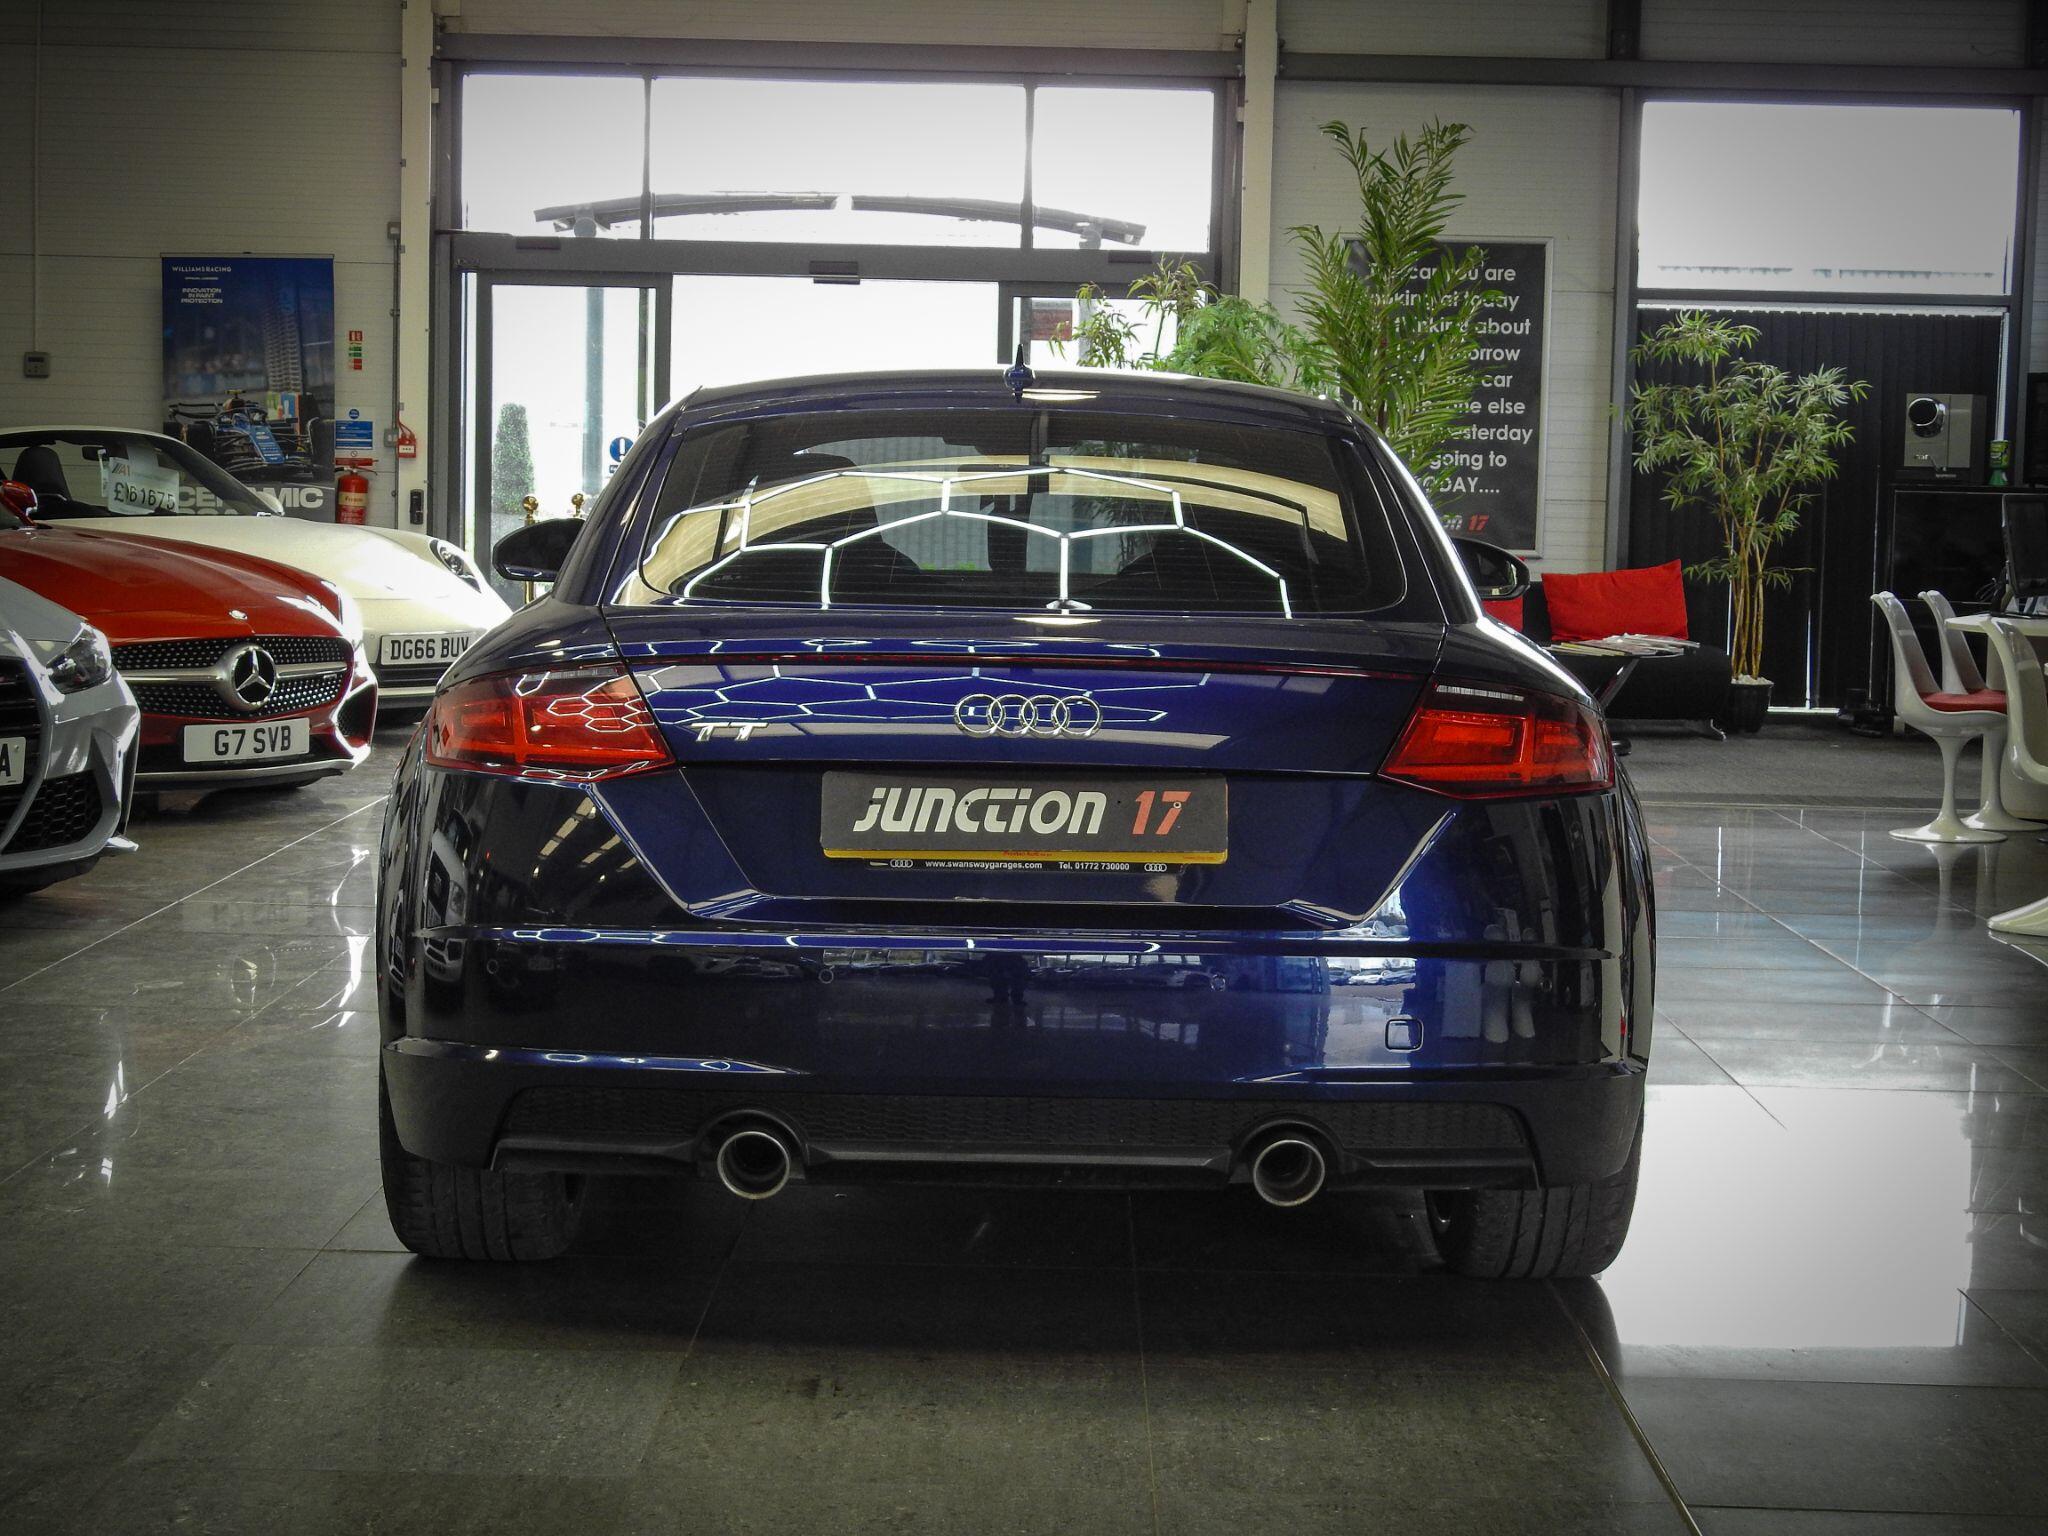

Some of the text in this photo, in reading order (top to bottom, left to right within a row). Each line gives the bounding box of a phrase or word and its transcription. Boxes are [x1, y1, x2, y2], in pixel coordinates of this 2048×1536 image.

[1484, 268, 1516, 281] are
[1475, 318, 1531, 335] about
[1481, 374, 1513, 388] car
[1487, 398, 1526, 415] else
[1429, 451, 1483, 470] going
[1489, 450, 1507, 467] to
[390, 638, 436, 660] DG66
[214, 725, 292, 756] G7 SVB
[690, 722, 770, 742] TT
[1131, 791, 1191, 835] 17
[925, 860, 1130, 871] www.swanswaygarages.com Tel. 01772 730000
